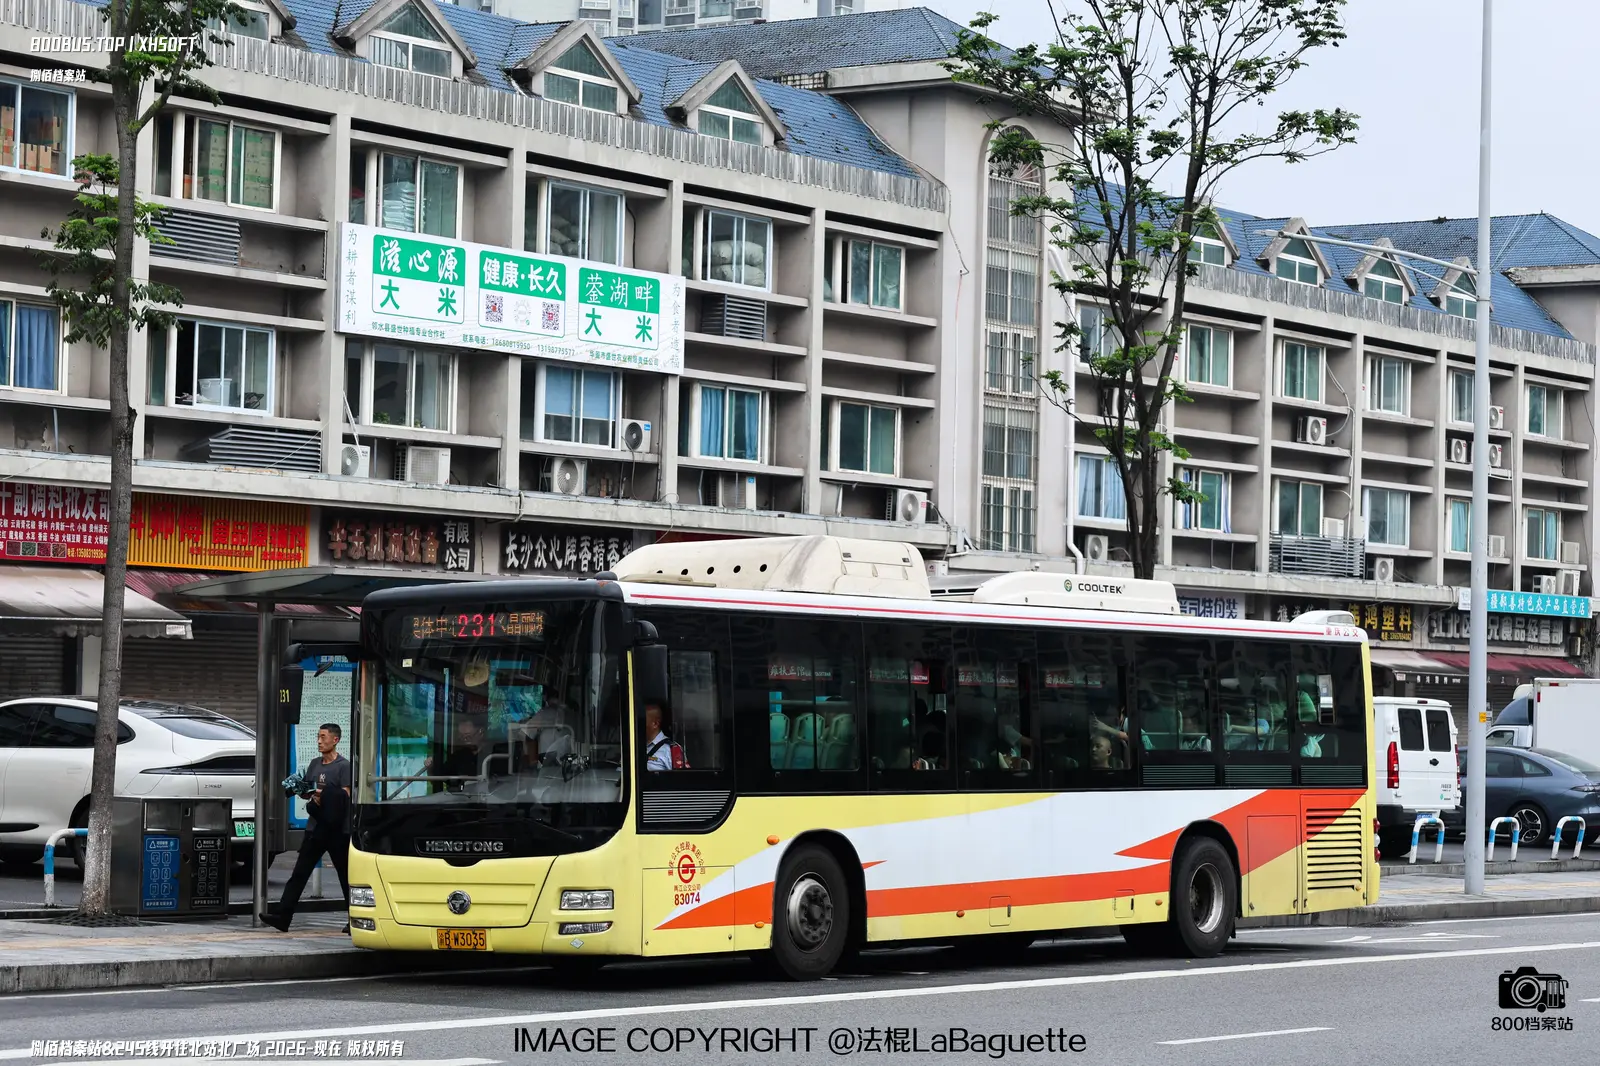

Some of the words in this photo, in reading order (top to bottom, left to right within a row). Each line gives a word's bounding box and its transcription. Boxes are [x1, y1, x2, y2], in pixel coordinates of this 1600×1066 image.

[379, 239, 459, 283] 滋心源
[445, 547, 470, 571] 公司
[1078, 583, 1122, 594] COOLTEK
[458, 613, 496, 637] 231
[1325, 627, 1359, 637] 重庆公交
[426, 840, 504, 852] HENGTONG
[674, 892, 700, 906] 83074
